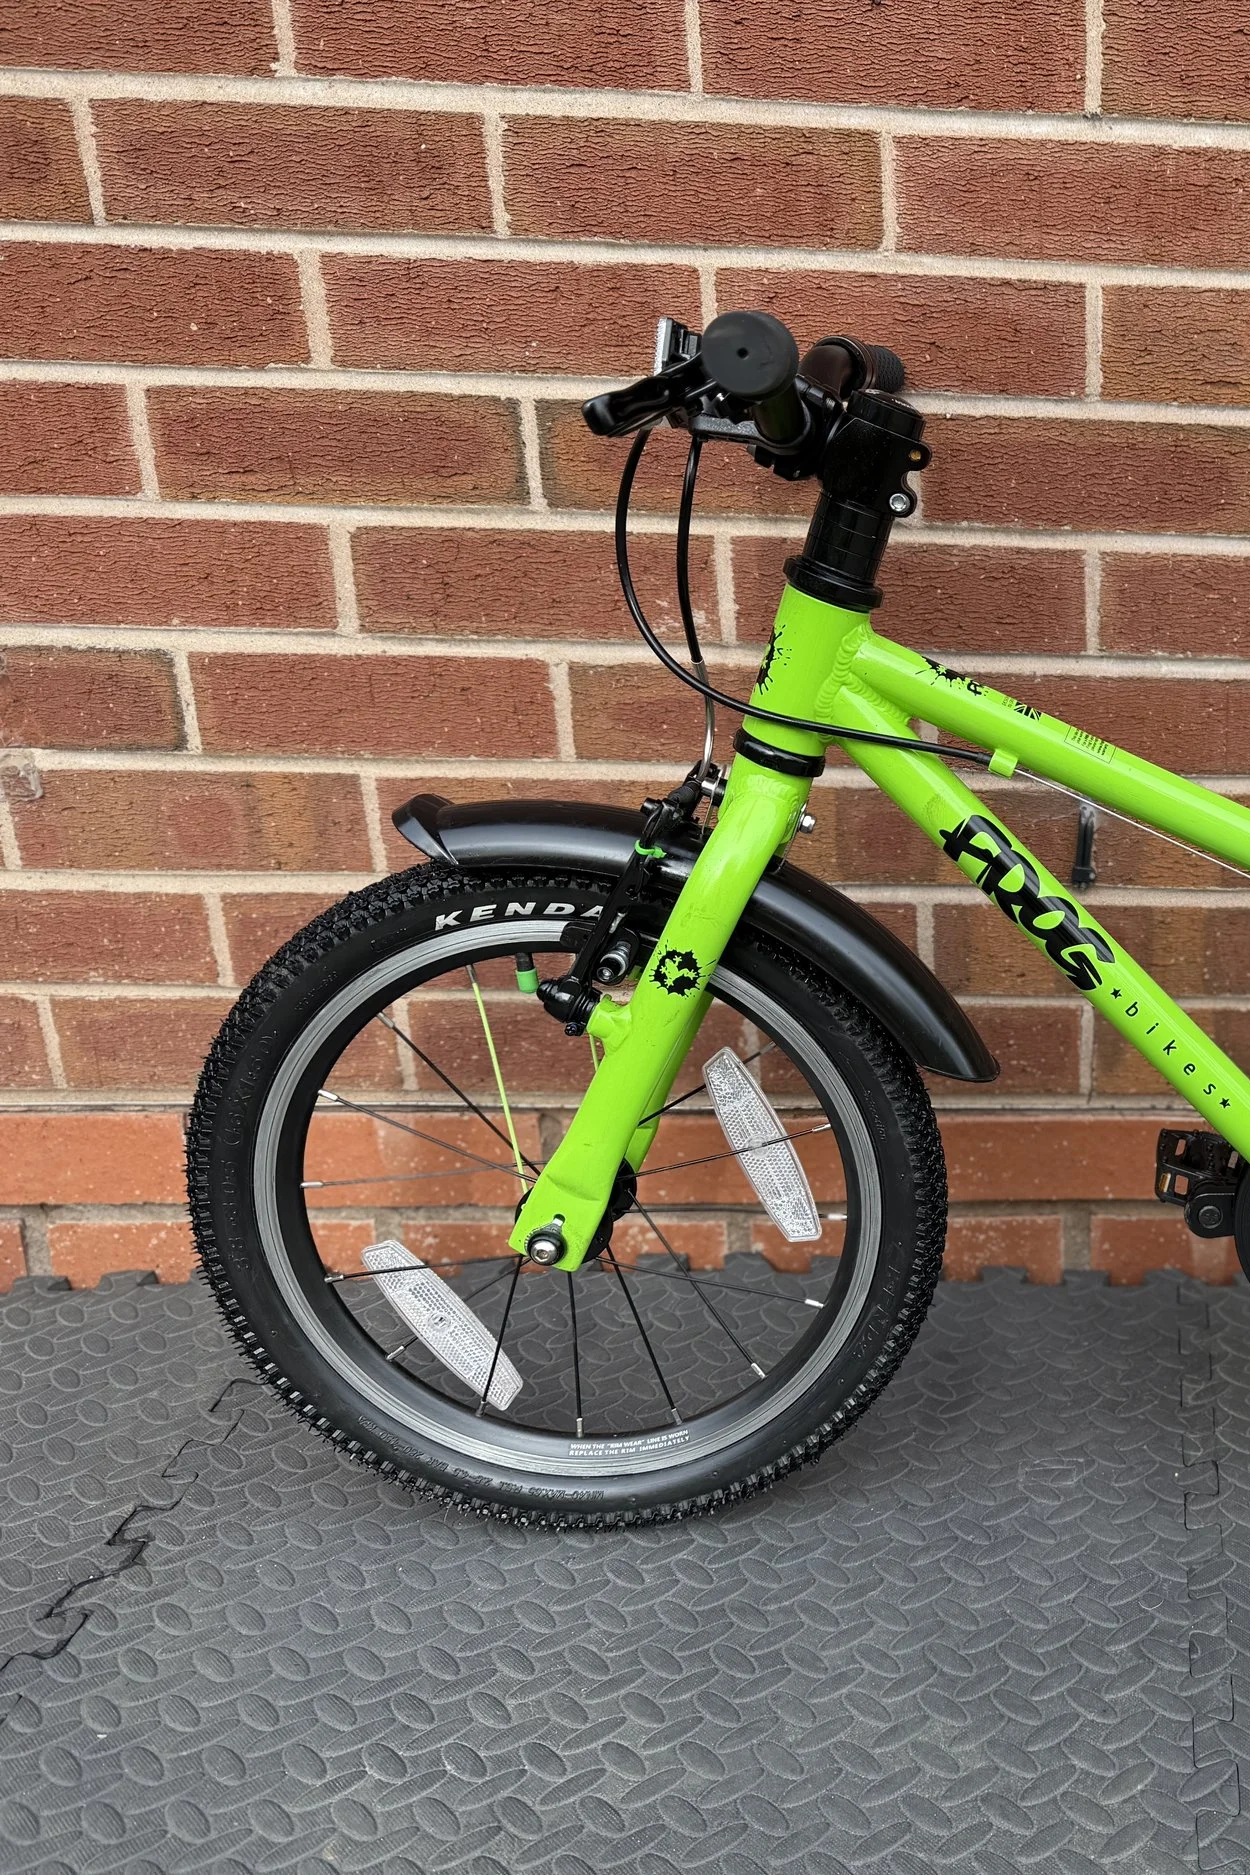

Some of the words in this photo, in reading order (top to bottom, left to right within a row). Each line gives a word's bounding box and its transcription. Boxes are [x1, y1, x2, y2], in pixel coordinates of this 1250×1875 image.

[434, 902, 604, 931] KENDA
[939, 815, 1116, 991] FROG
[1125, 1001, 1217, 1096] bikes
[639, 1435, 690, 1452] IMMEDIATELY
[647, 1436, 661, 1444] LINE
[668, 1430, 689, 1440] WORN
